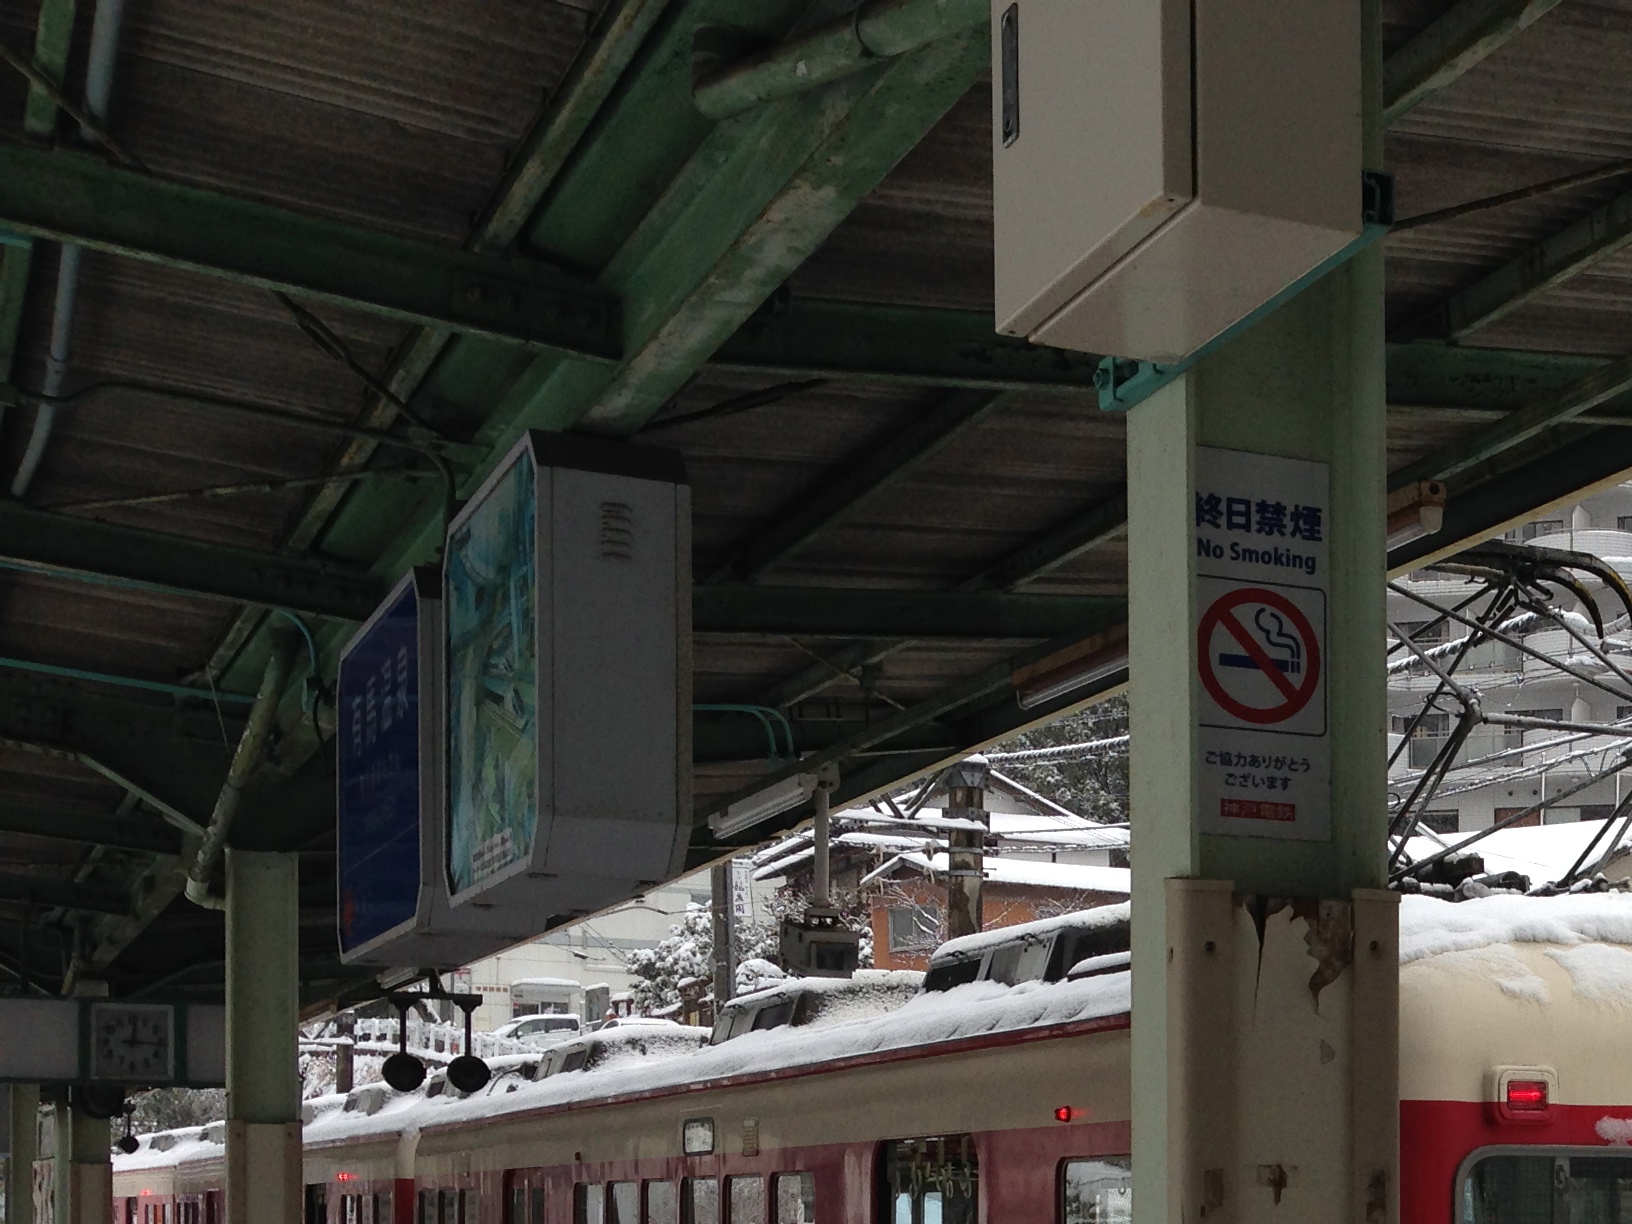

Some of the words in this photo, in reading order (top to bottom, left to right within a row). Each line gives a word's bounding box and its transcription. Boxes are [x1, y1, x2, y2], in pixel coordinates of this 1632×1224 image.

[1195, 491, 1323, 542] 終日禁煙
[1197, 538, 1224, 559] No
[1230, 541, 1317, 575] Smoking
[1205, 751, 1311, 773] ご協力ありがとう
[1224, 773, 1292, 791] ございます
